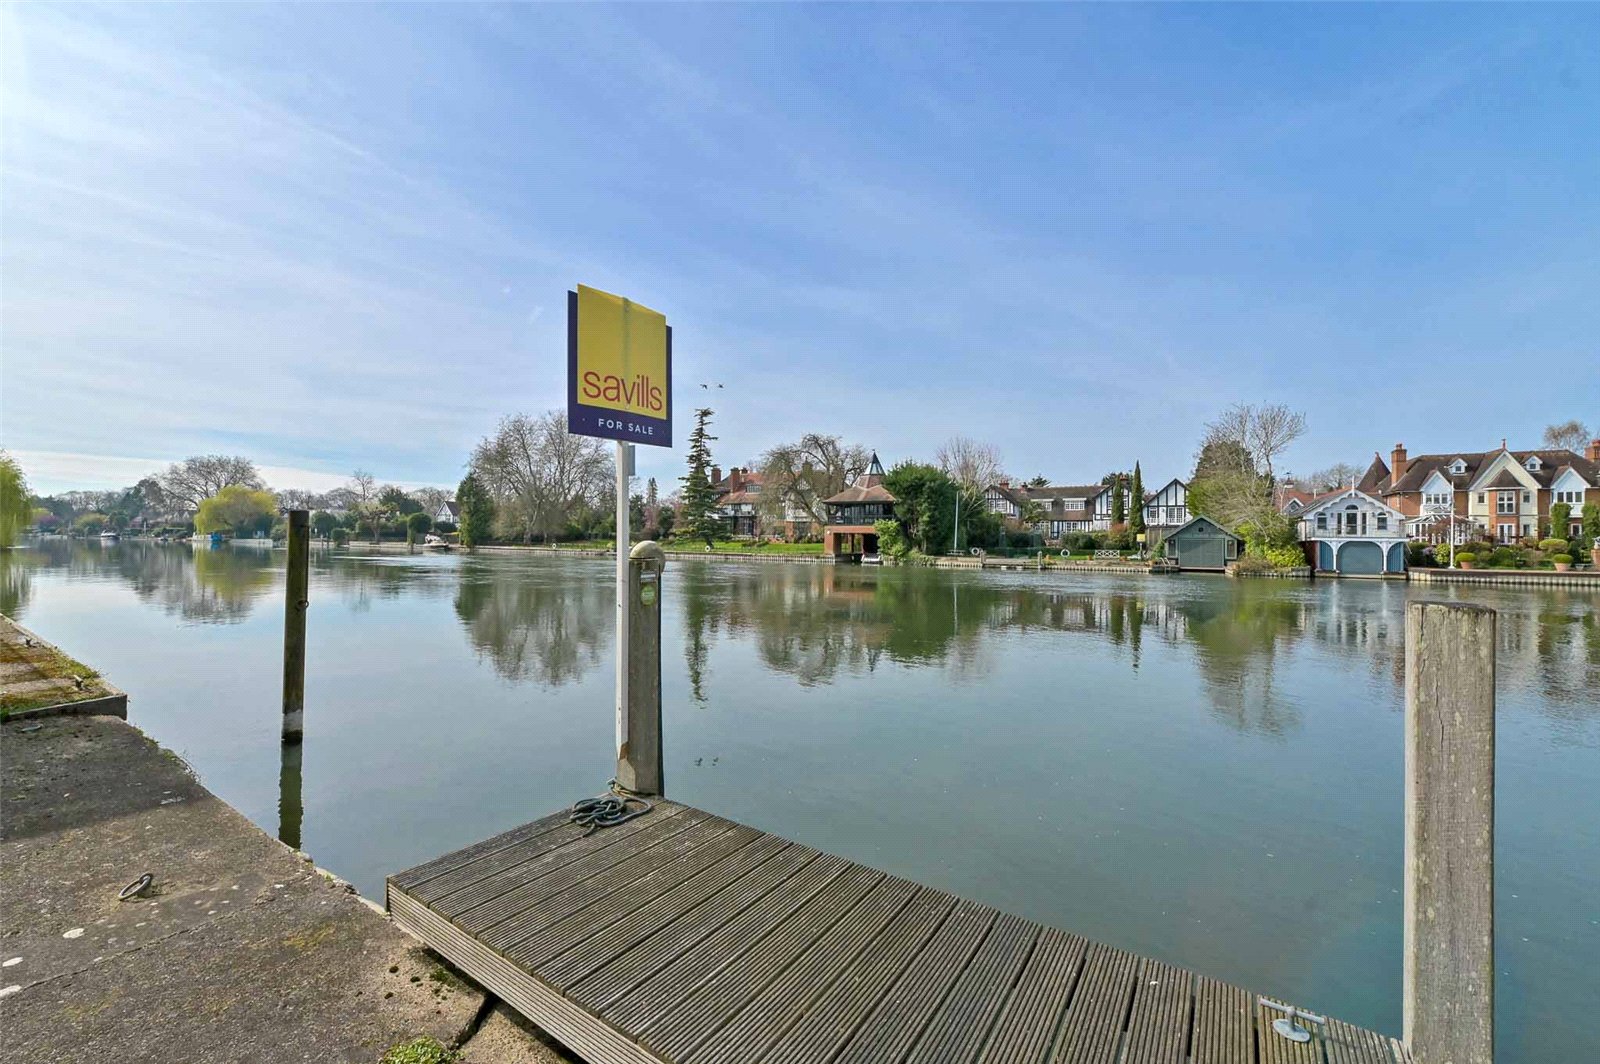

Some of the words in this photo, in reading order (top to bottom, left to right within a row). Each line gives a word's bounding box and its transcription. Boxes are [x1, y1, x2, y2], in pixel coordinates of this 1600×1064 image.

[582, 371, 662, 411] savills
[598, 418, 623, 430] FOR
[628, 423, 654, 435] SALE
